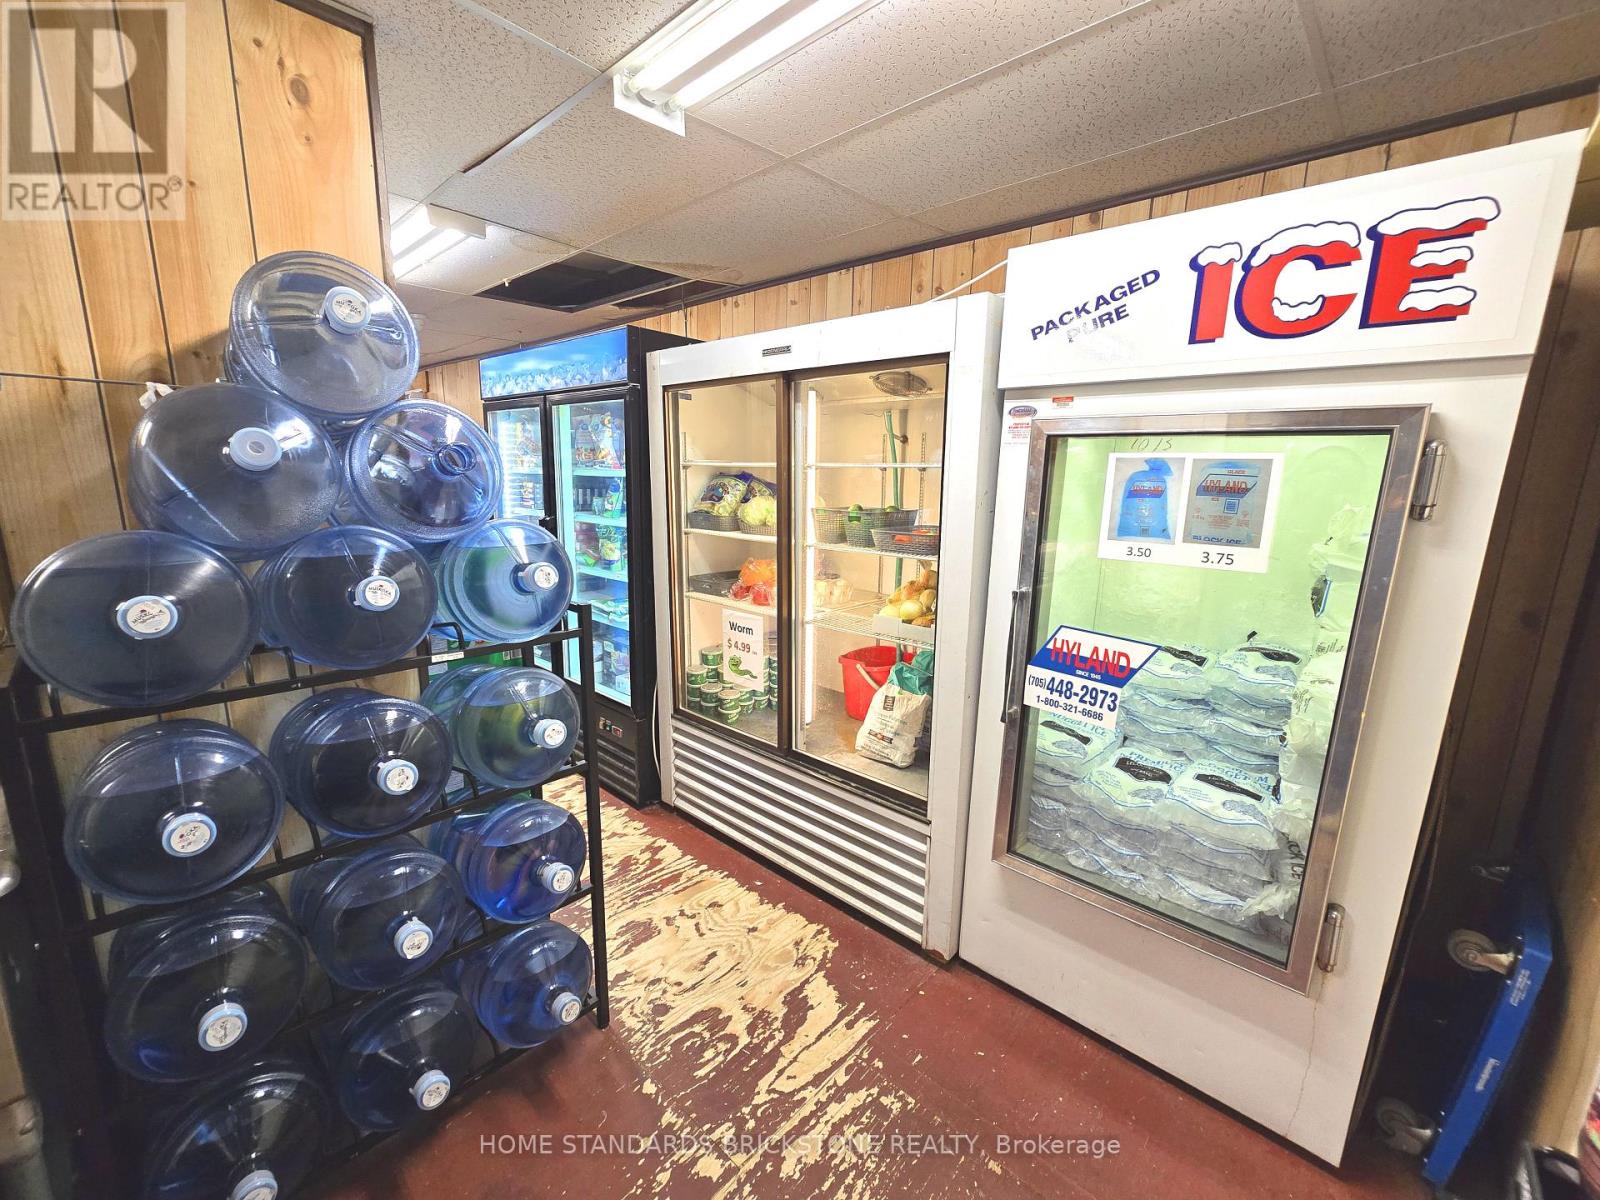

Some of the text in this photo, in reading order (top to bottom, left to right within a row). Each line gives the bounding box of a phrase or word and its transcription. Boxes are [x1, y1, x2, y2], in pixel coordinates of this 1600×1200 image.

[1188, 195, 1502, 346] ICE
[1030, 269, 1161, 341] PACKAGED
[1066, 303, 1130, 343] PURE
[1126, 546, 1152, 558] 3.50
[1200, 551, 1235, 566] 3.75
[728, 620, 754, 636] Worm
[1053, 637, 1131, 680] HYLAND
[1028, 674, 1119, 713] (705) 448-2973
[1036, 695, 1104, 722] 1-800-321-6686
